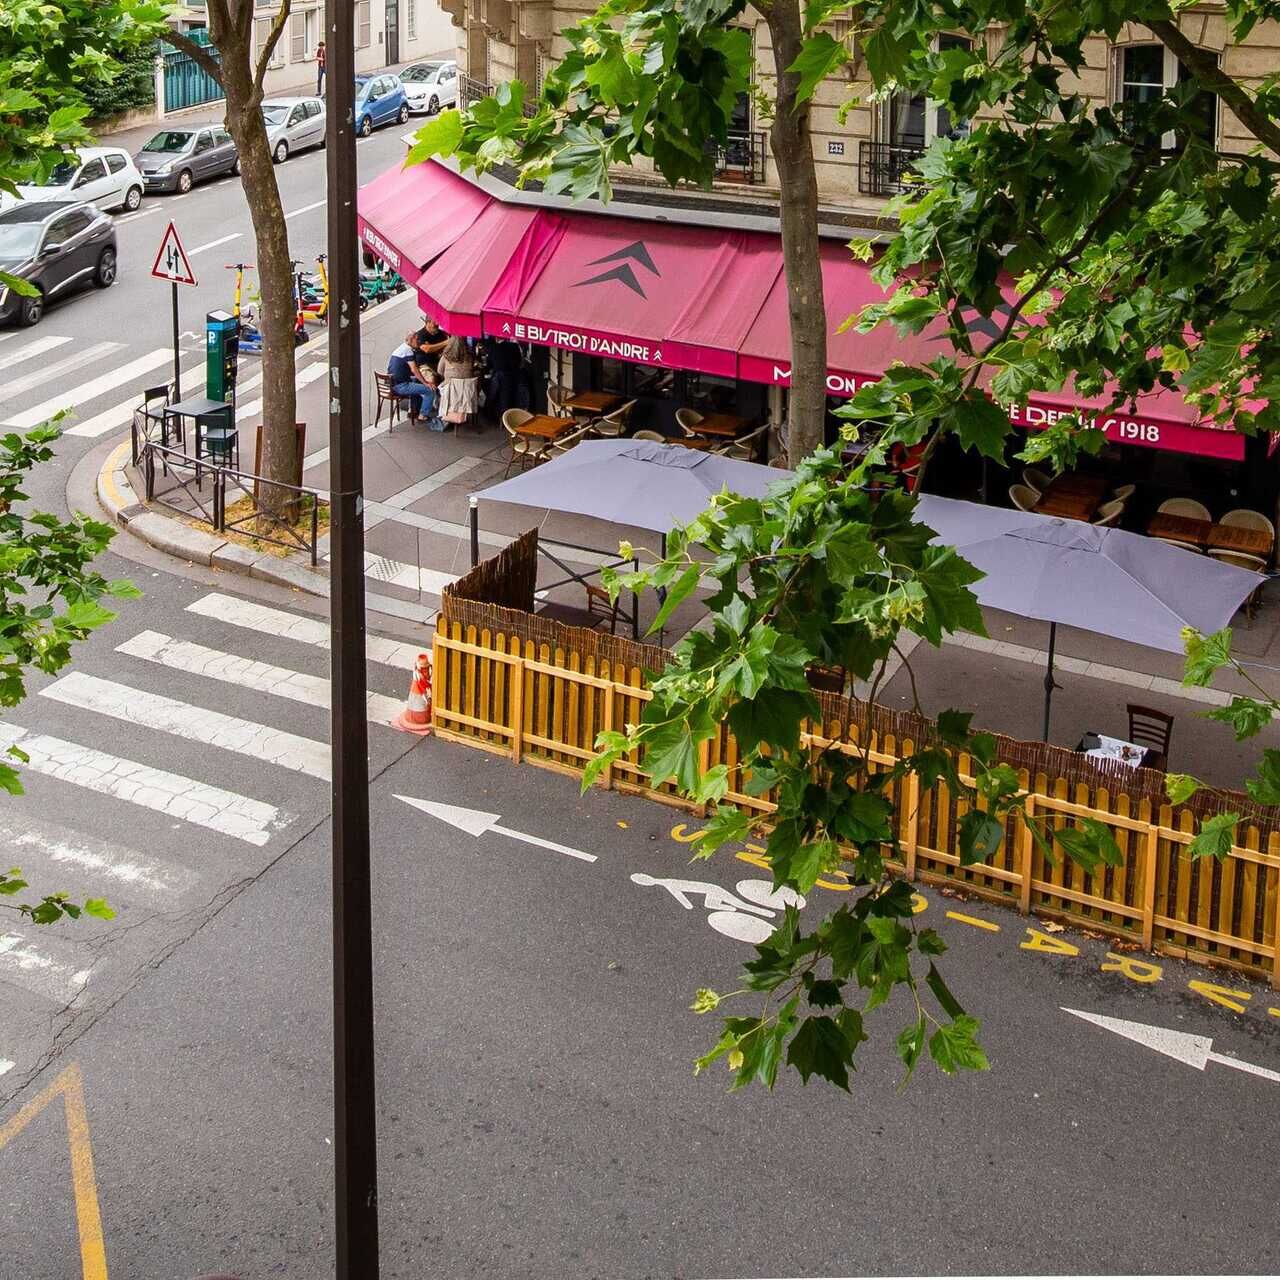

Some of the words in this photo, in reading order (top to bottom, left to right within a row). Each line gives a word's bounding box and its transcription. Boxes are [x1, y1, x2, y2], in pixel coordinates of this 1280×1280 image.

[829, 144, 843, 153] 232
[515, 323, 525, 338] LE
[527, 325, 588, 349] BISTROT
[590, 337, 649, 360] D'ANDRE
[1120, 421, 1160, 442] 1918
